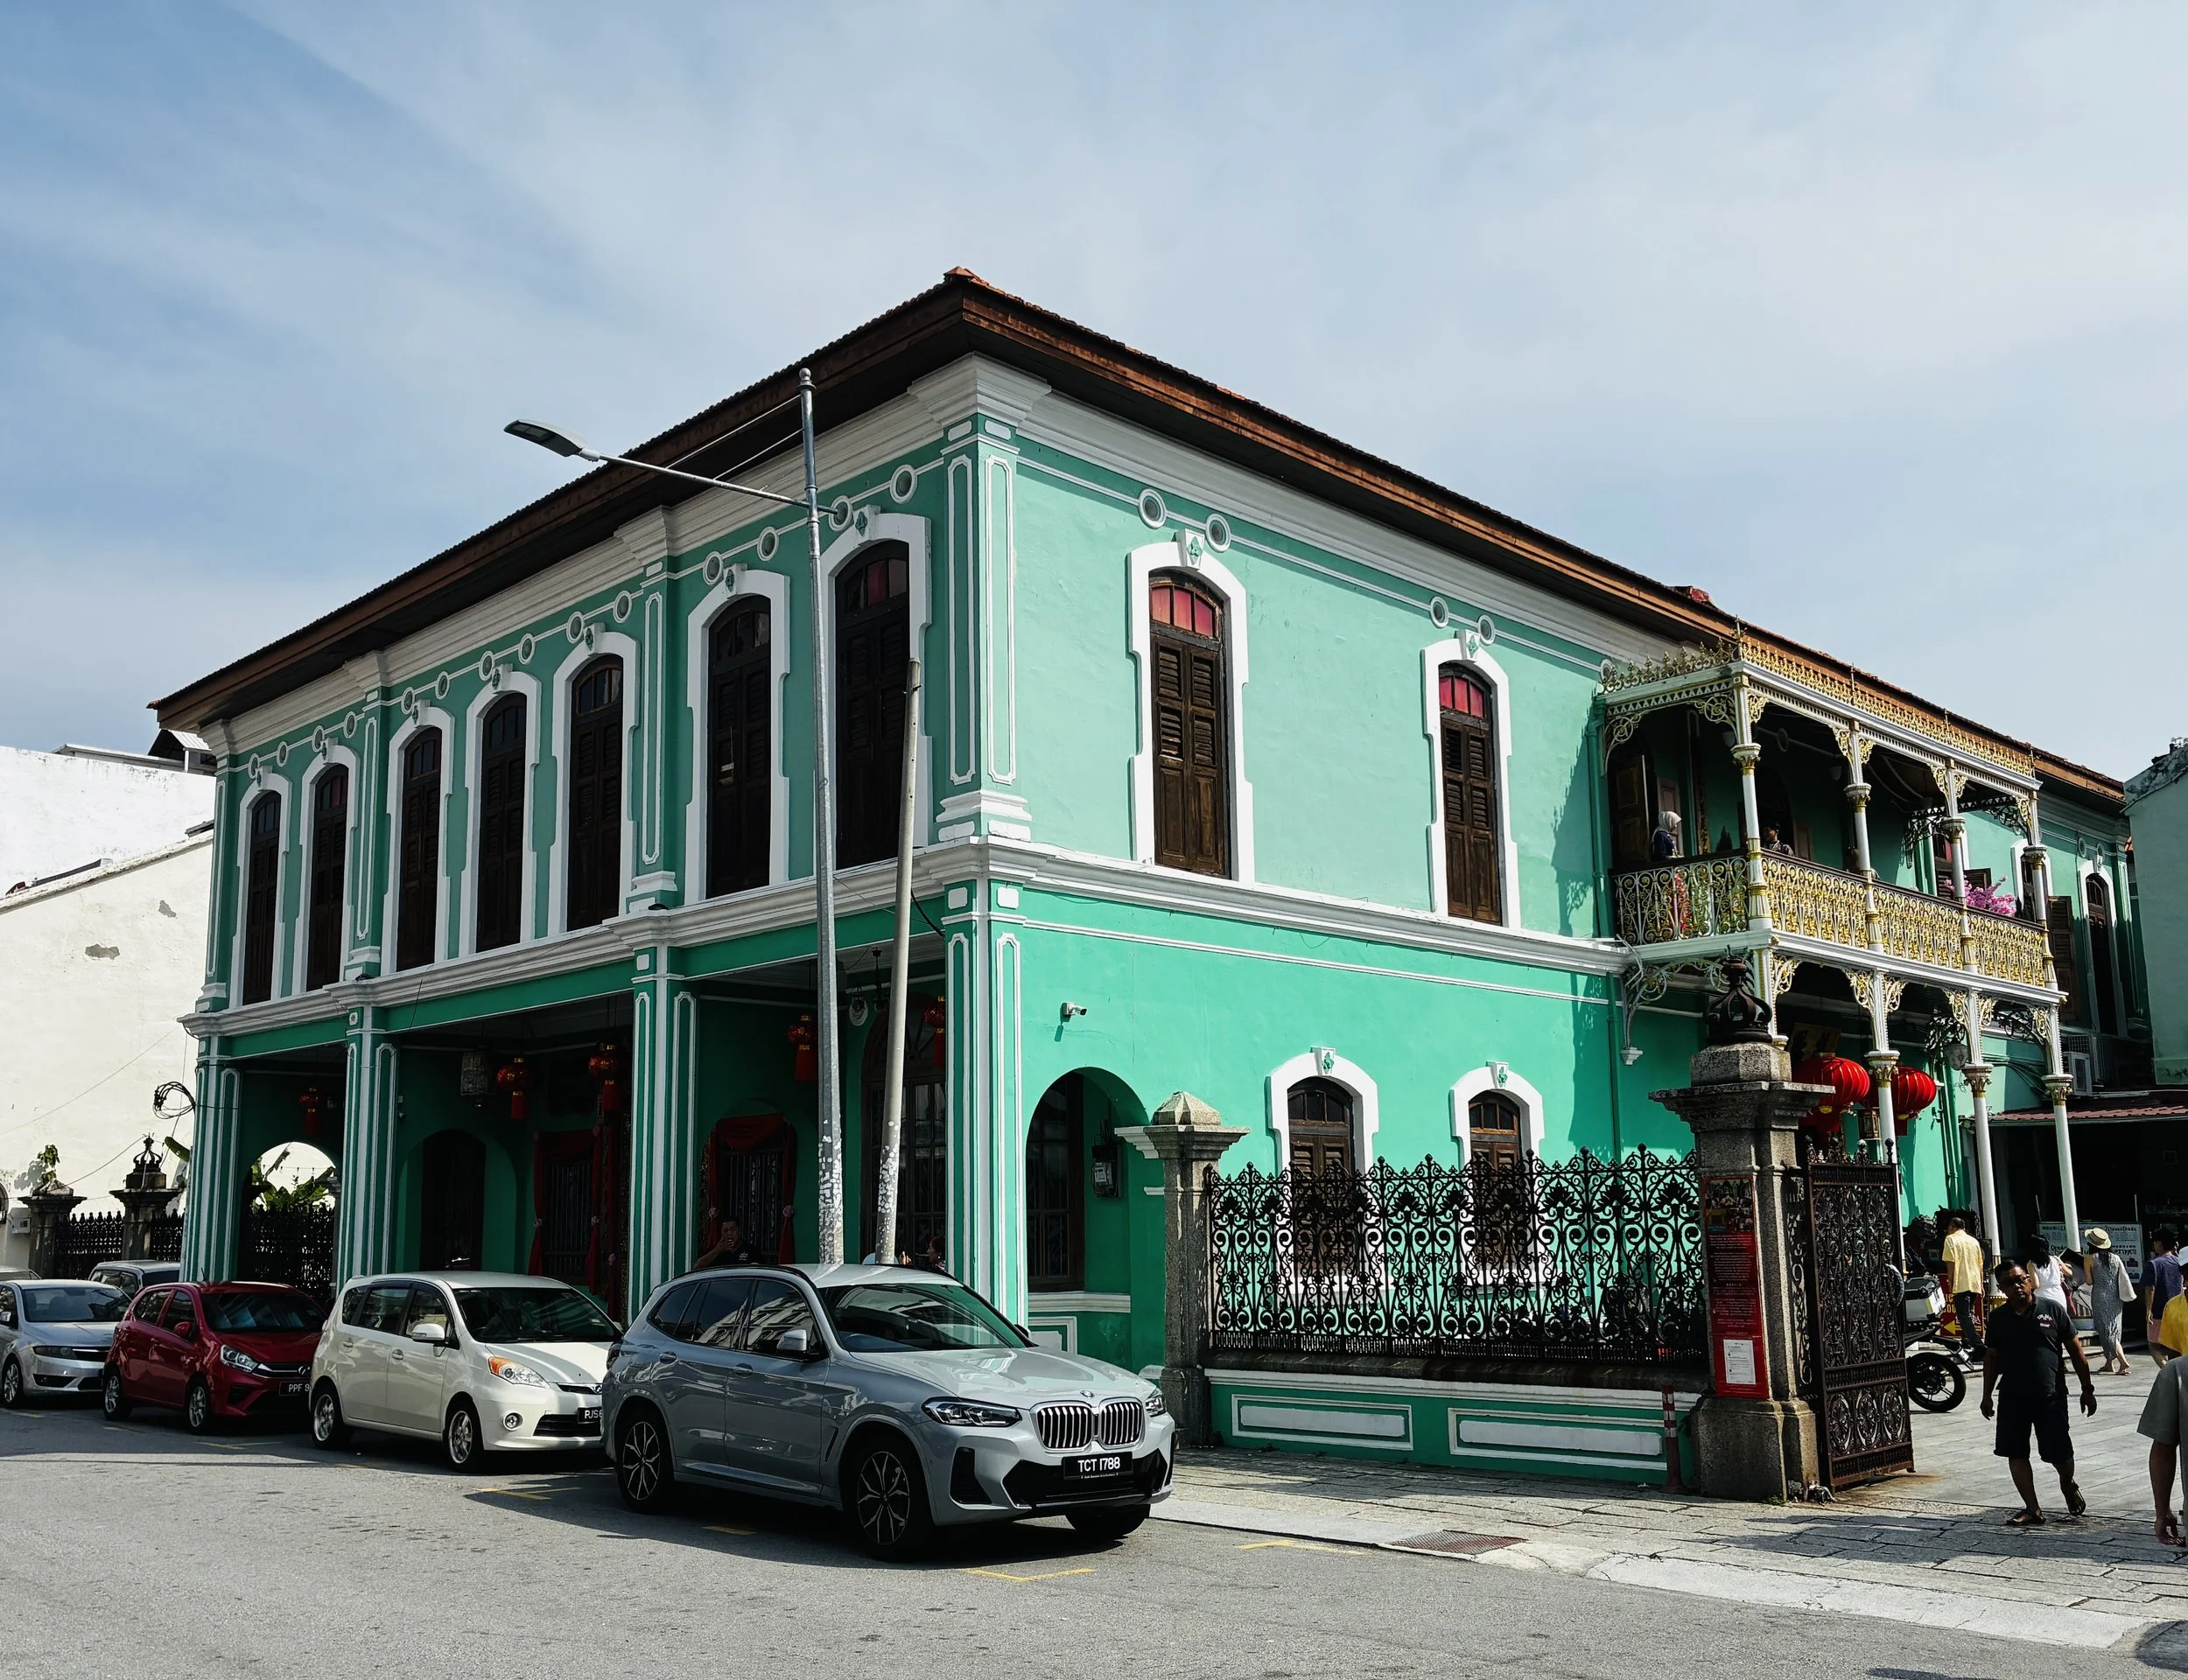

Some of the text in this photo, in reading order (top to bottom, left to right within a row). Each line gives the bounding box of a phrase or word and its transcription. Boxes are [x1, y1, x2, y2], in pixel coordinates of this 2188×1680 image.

[288, 1383, 303, 1392] PPF
[1077, 1456, 1120, 1473] TCT 1788
